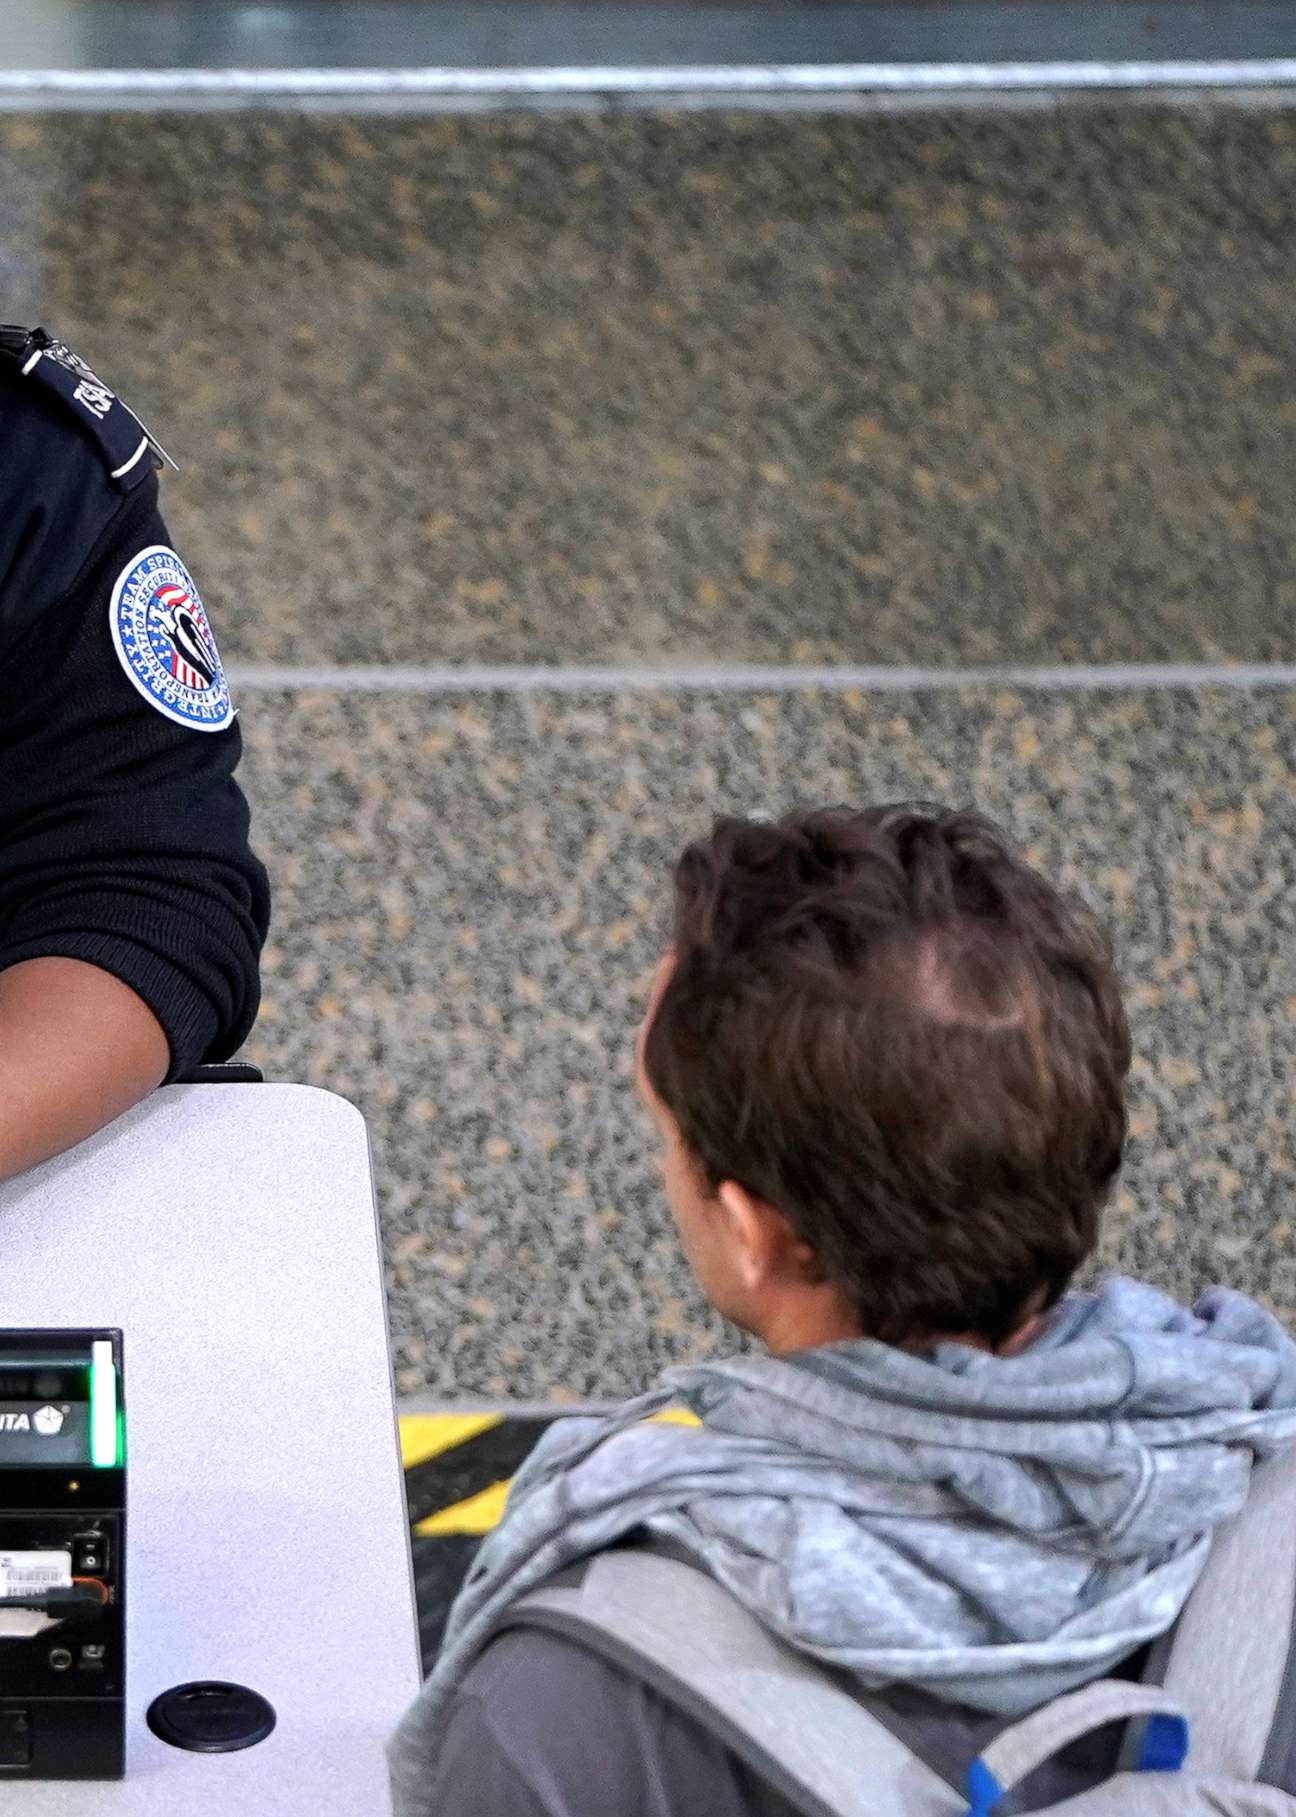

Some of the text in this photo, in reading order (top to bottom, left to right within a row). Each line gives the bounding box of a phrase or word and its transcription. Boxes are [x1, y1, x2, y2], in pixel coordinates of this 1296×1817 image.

[73, 379, 115, 419] TSA
[120, 566, 148, 621] TEAM
[125, 644, 218, 720] INTEGRITY
